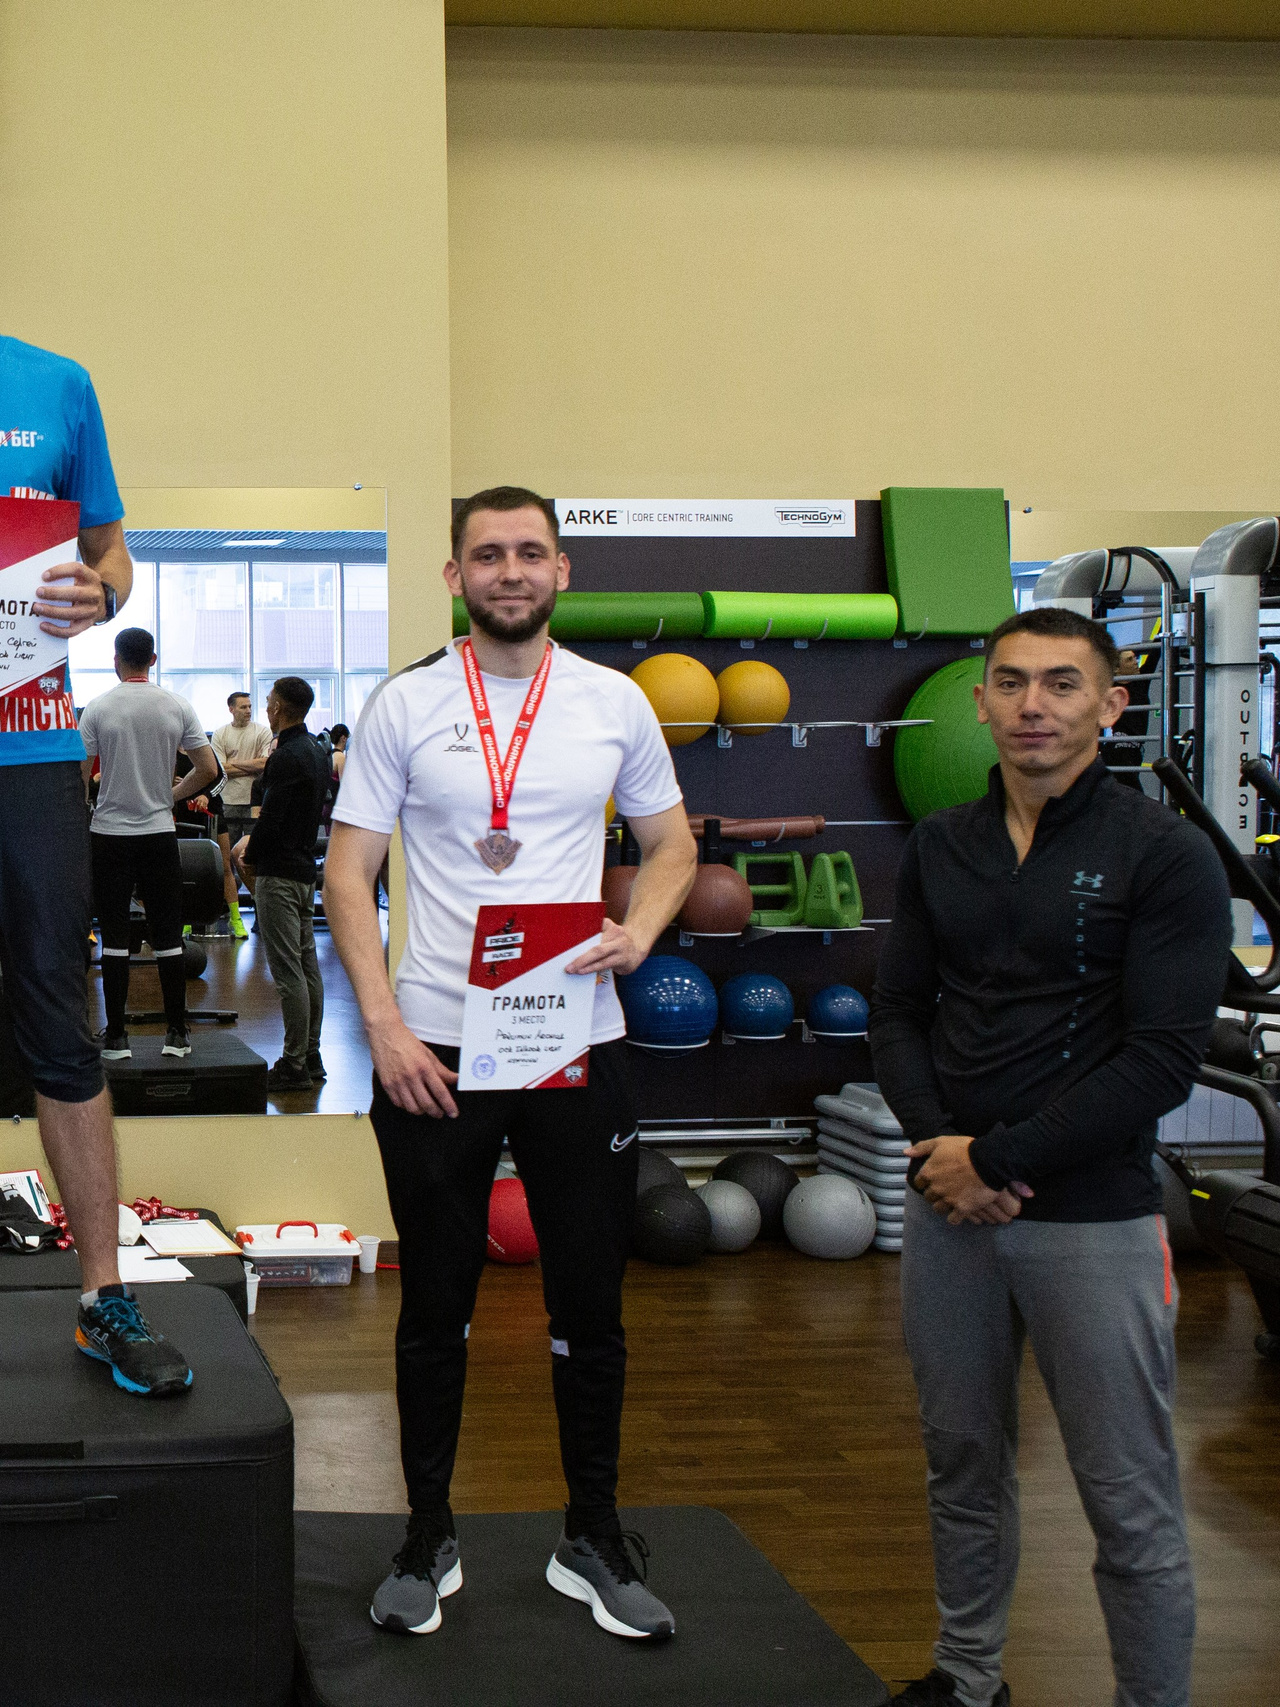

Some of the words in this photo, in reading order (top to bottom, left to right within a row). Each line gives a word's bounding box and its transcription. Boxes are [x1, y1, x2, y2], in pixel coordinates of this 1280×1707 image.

[564, 509, 618, 524] ARKE
[632, 513, 654, 522] CORE
[657, 513, 693, 522] CENTRIC
[695, 513, 734, 523] TRAINING
[7, 637, 37, 651] Сергей
[464, 645, 486, 711] CHAMPIONSHIP
[484, 733, 505, 808] CHAMPIONSHIP
[489, 934, 520, 945] PRIDE
[492, 950, 515, 959] RACE
[492, 994, 566, 1011] ГРАМОТА
[519, 1015, 546, 1024] МЕСТО
